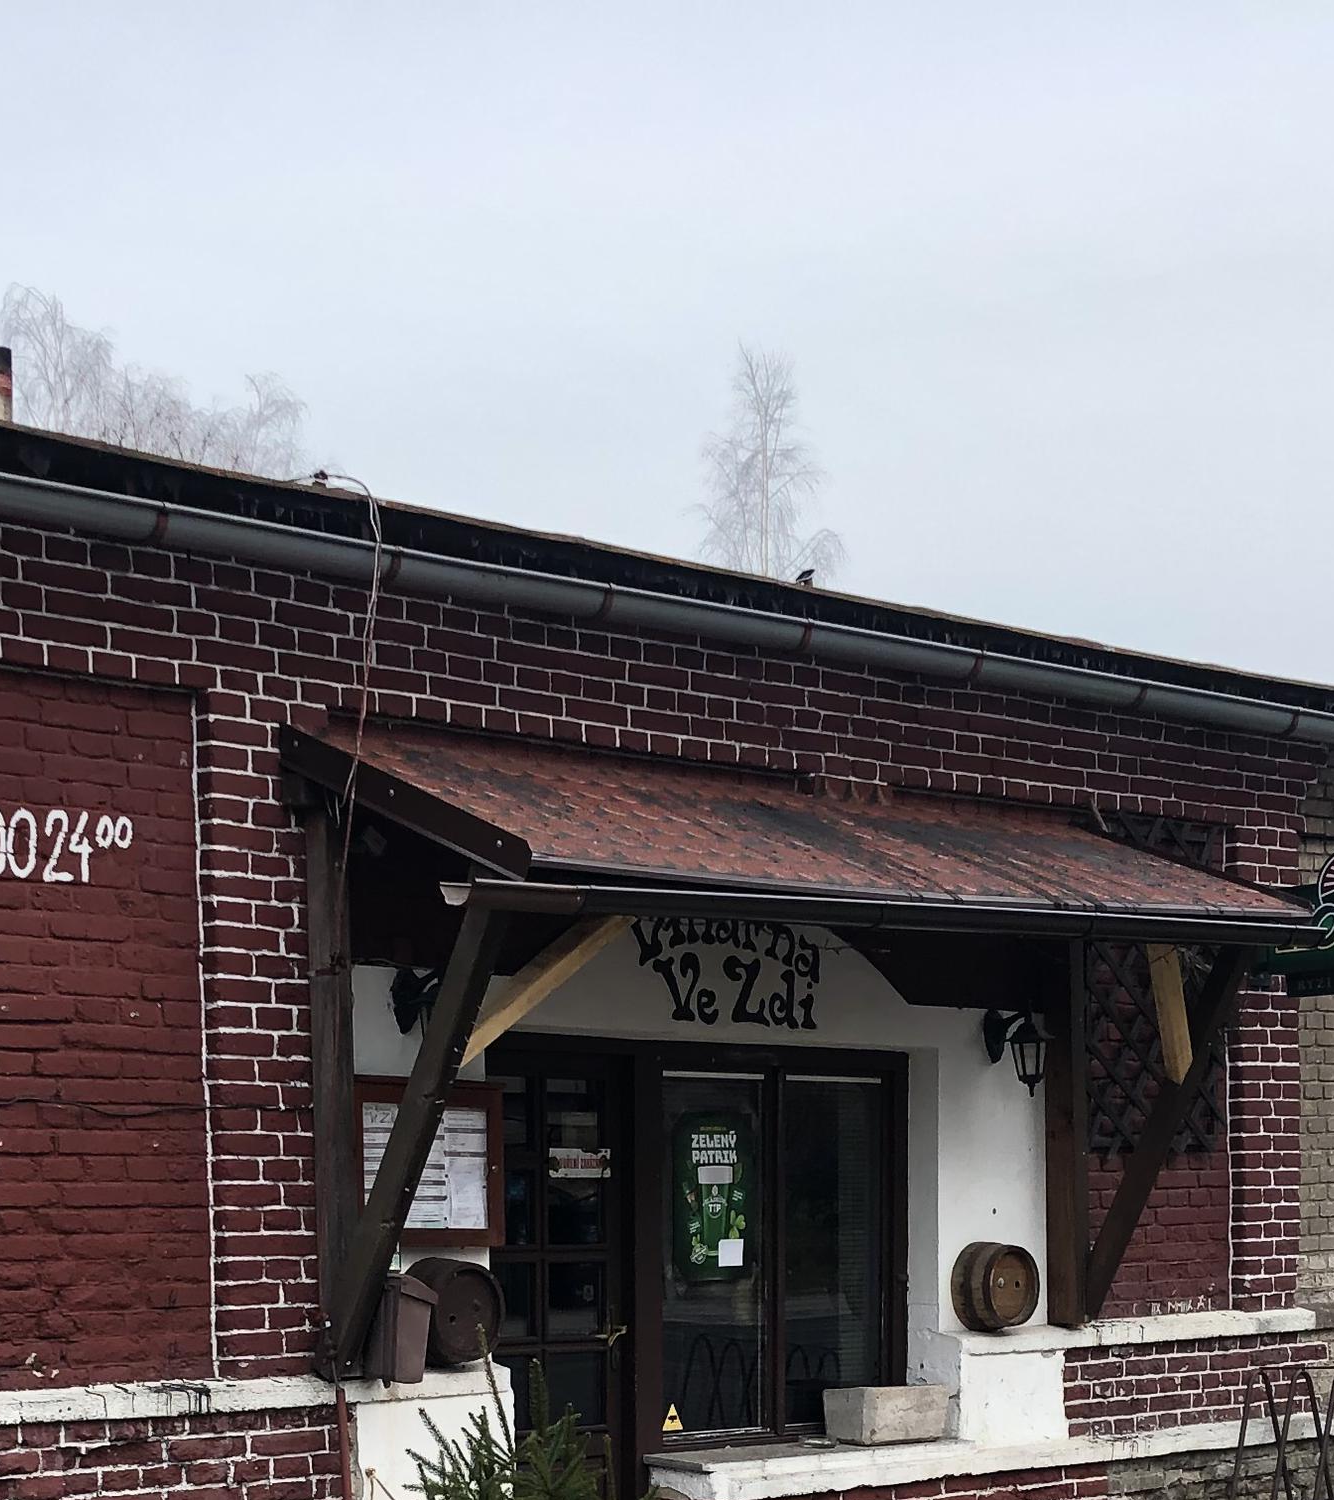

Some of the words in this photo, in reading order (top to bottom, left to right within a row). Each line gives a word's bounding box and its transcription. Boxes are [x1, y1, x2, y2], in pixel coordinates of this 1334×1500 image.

[653, 952, 719, 1025] Ve
[723, 955, 818, 1029] Zdi
[691, 1130, 737, 1148] ZELENÝ
[691, 1150, 738, 1164] PATRIK
